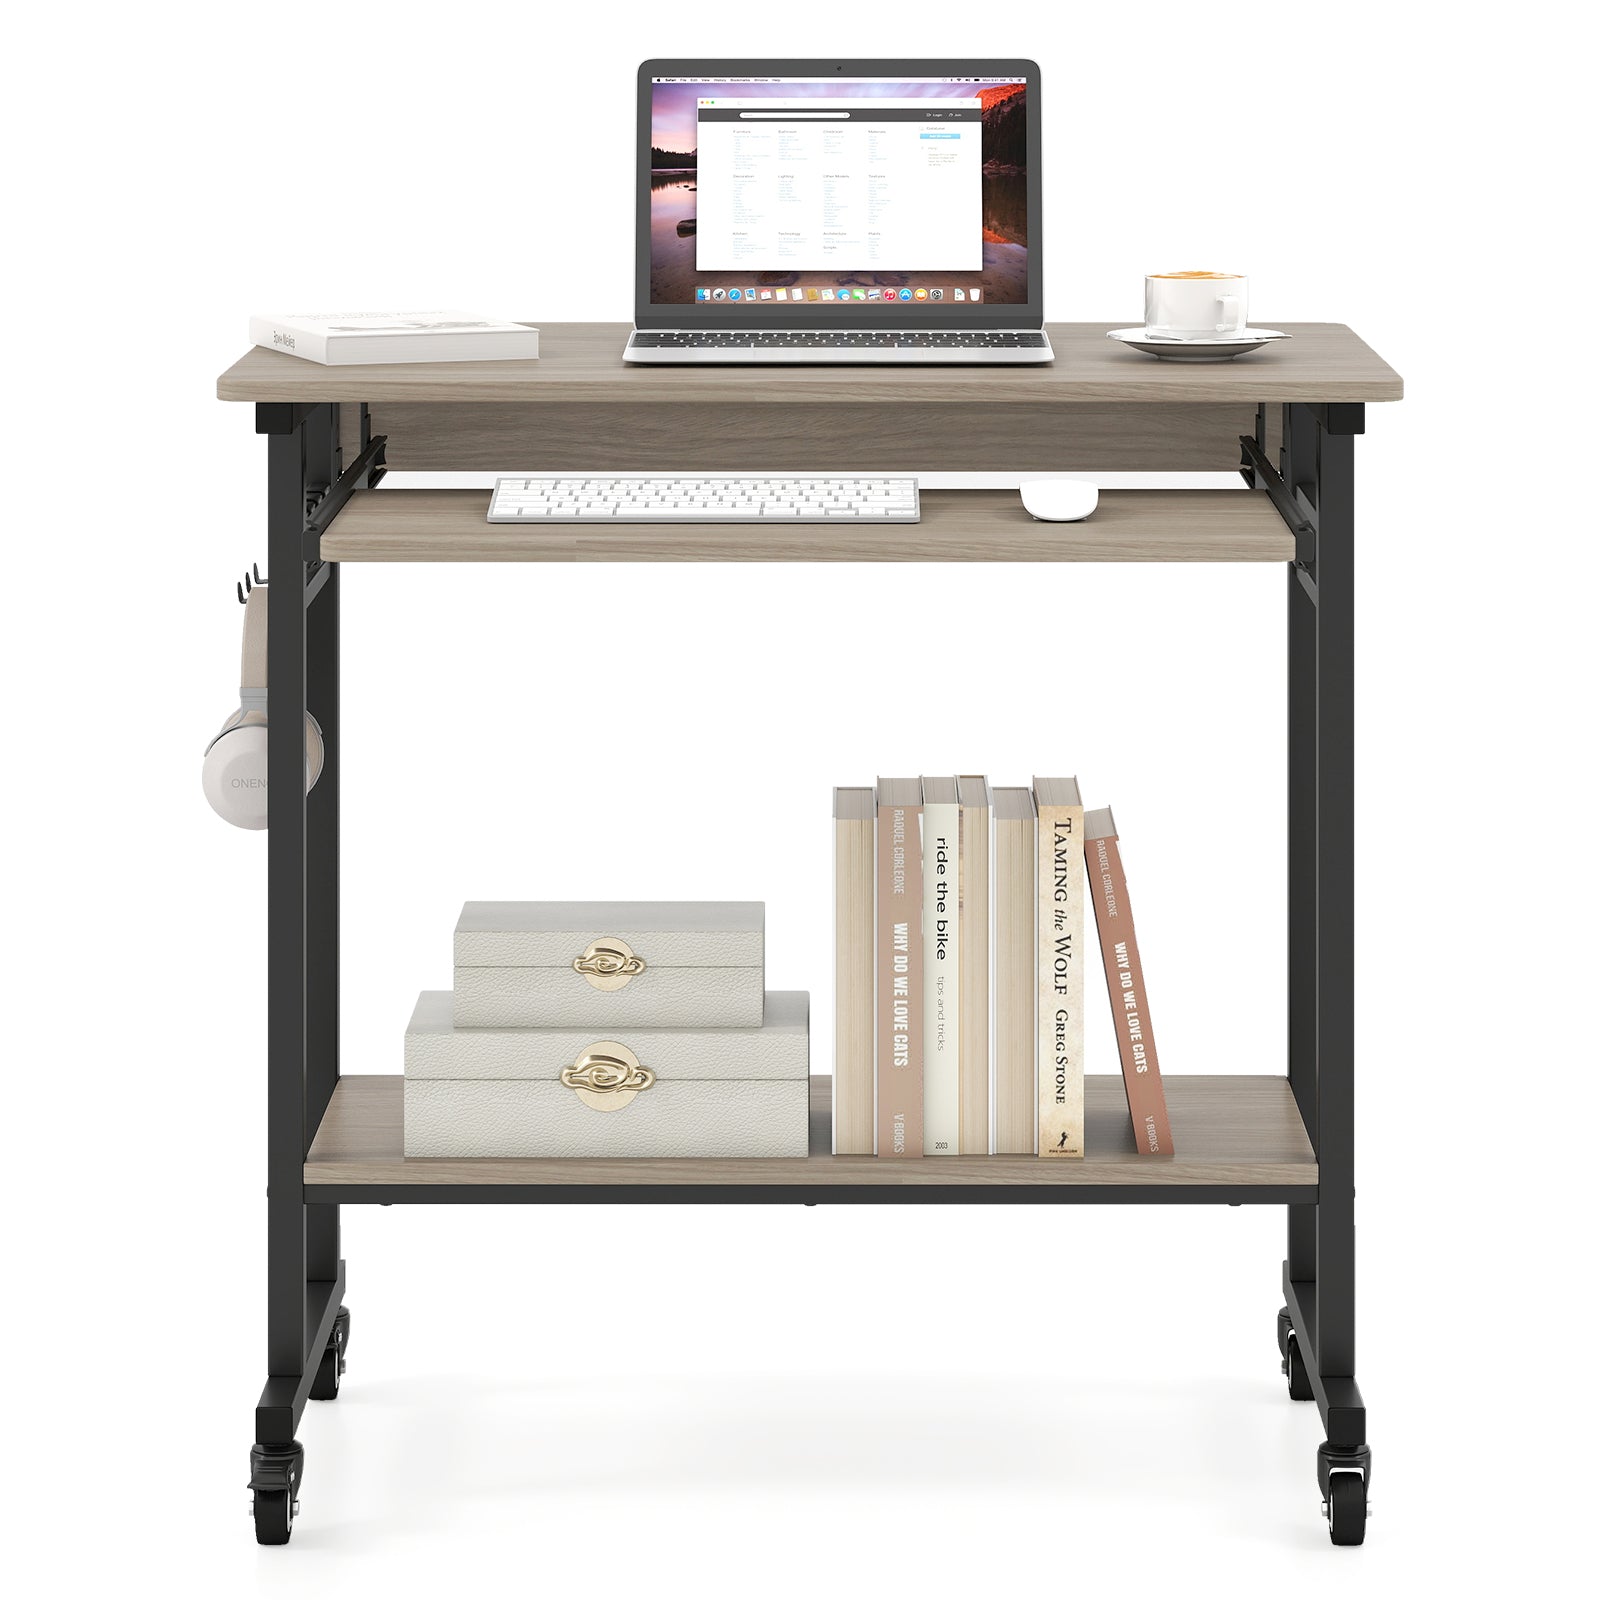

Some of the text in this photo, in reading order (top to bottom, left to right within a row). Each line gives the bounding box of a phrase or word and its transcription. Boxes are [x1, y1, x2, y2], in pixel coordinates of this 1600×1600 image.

[231, 778, 268, 789] ONEN
[893, 809, 905, 894] RAQUEL CORLEONE
[1096, 840, 1109, 873] RAQUEL
[936, 837, 949, 961] ride the bike
[1054, 909, 1068, 931] the
[893, 922, 909, 1068] WHY DO WE LOVE CATS
[937, 976, 946, 1051] tips and tricks
[1114, 941, 1148, 1074] WHY DO WE LOVE CATS
[935, 1141, 948, 1150] 2003
